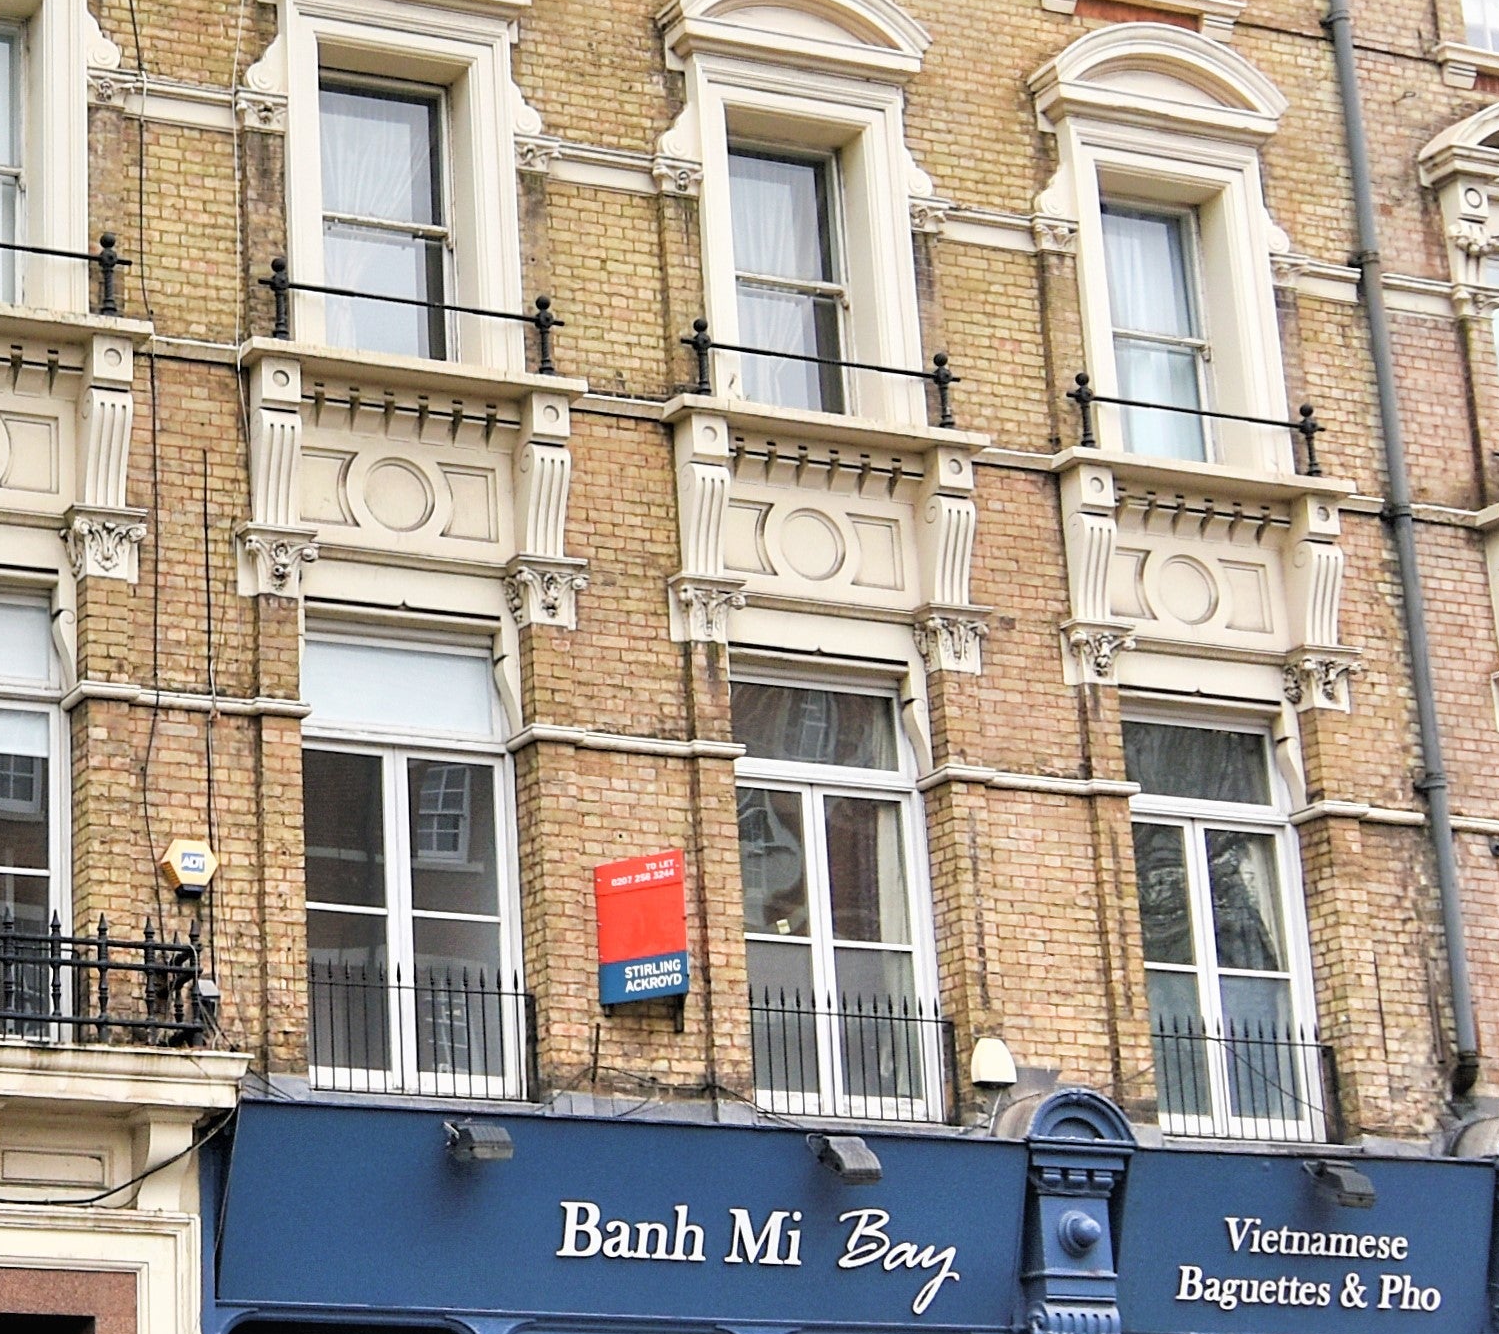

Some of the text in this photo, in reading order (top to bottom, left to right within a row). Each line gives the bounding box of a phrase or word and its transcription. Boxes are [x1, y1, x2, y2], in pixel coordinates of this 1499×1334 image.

[182, 855, 204, 870] ADT
[646, 859, 675, 871] TO LET
[611, 875, 632, 887] 0207
[624, 959, 682, 979] STIRLING
[625, 973, 683, 993] ACKROYD
[1223, 1216, 1409, 1260] Vietnamese
[556, 1200, 961, 1315] Banh Mi Bay
[1175, 1264, 1442, 1312] Baguettes & Pho
